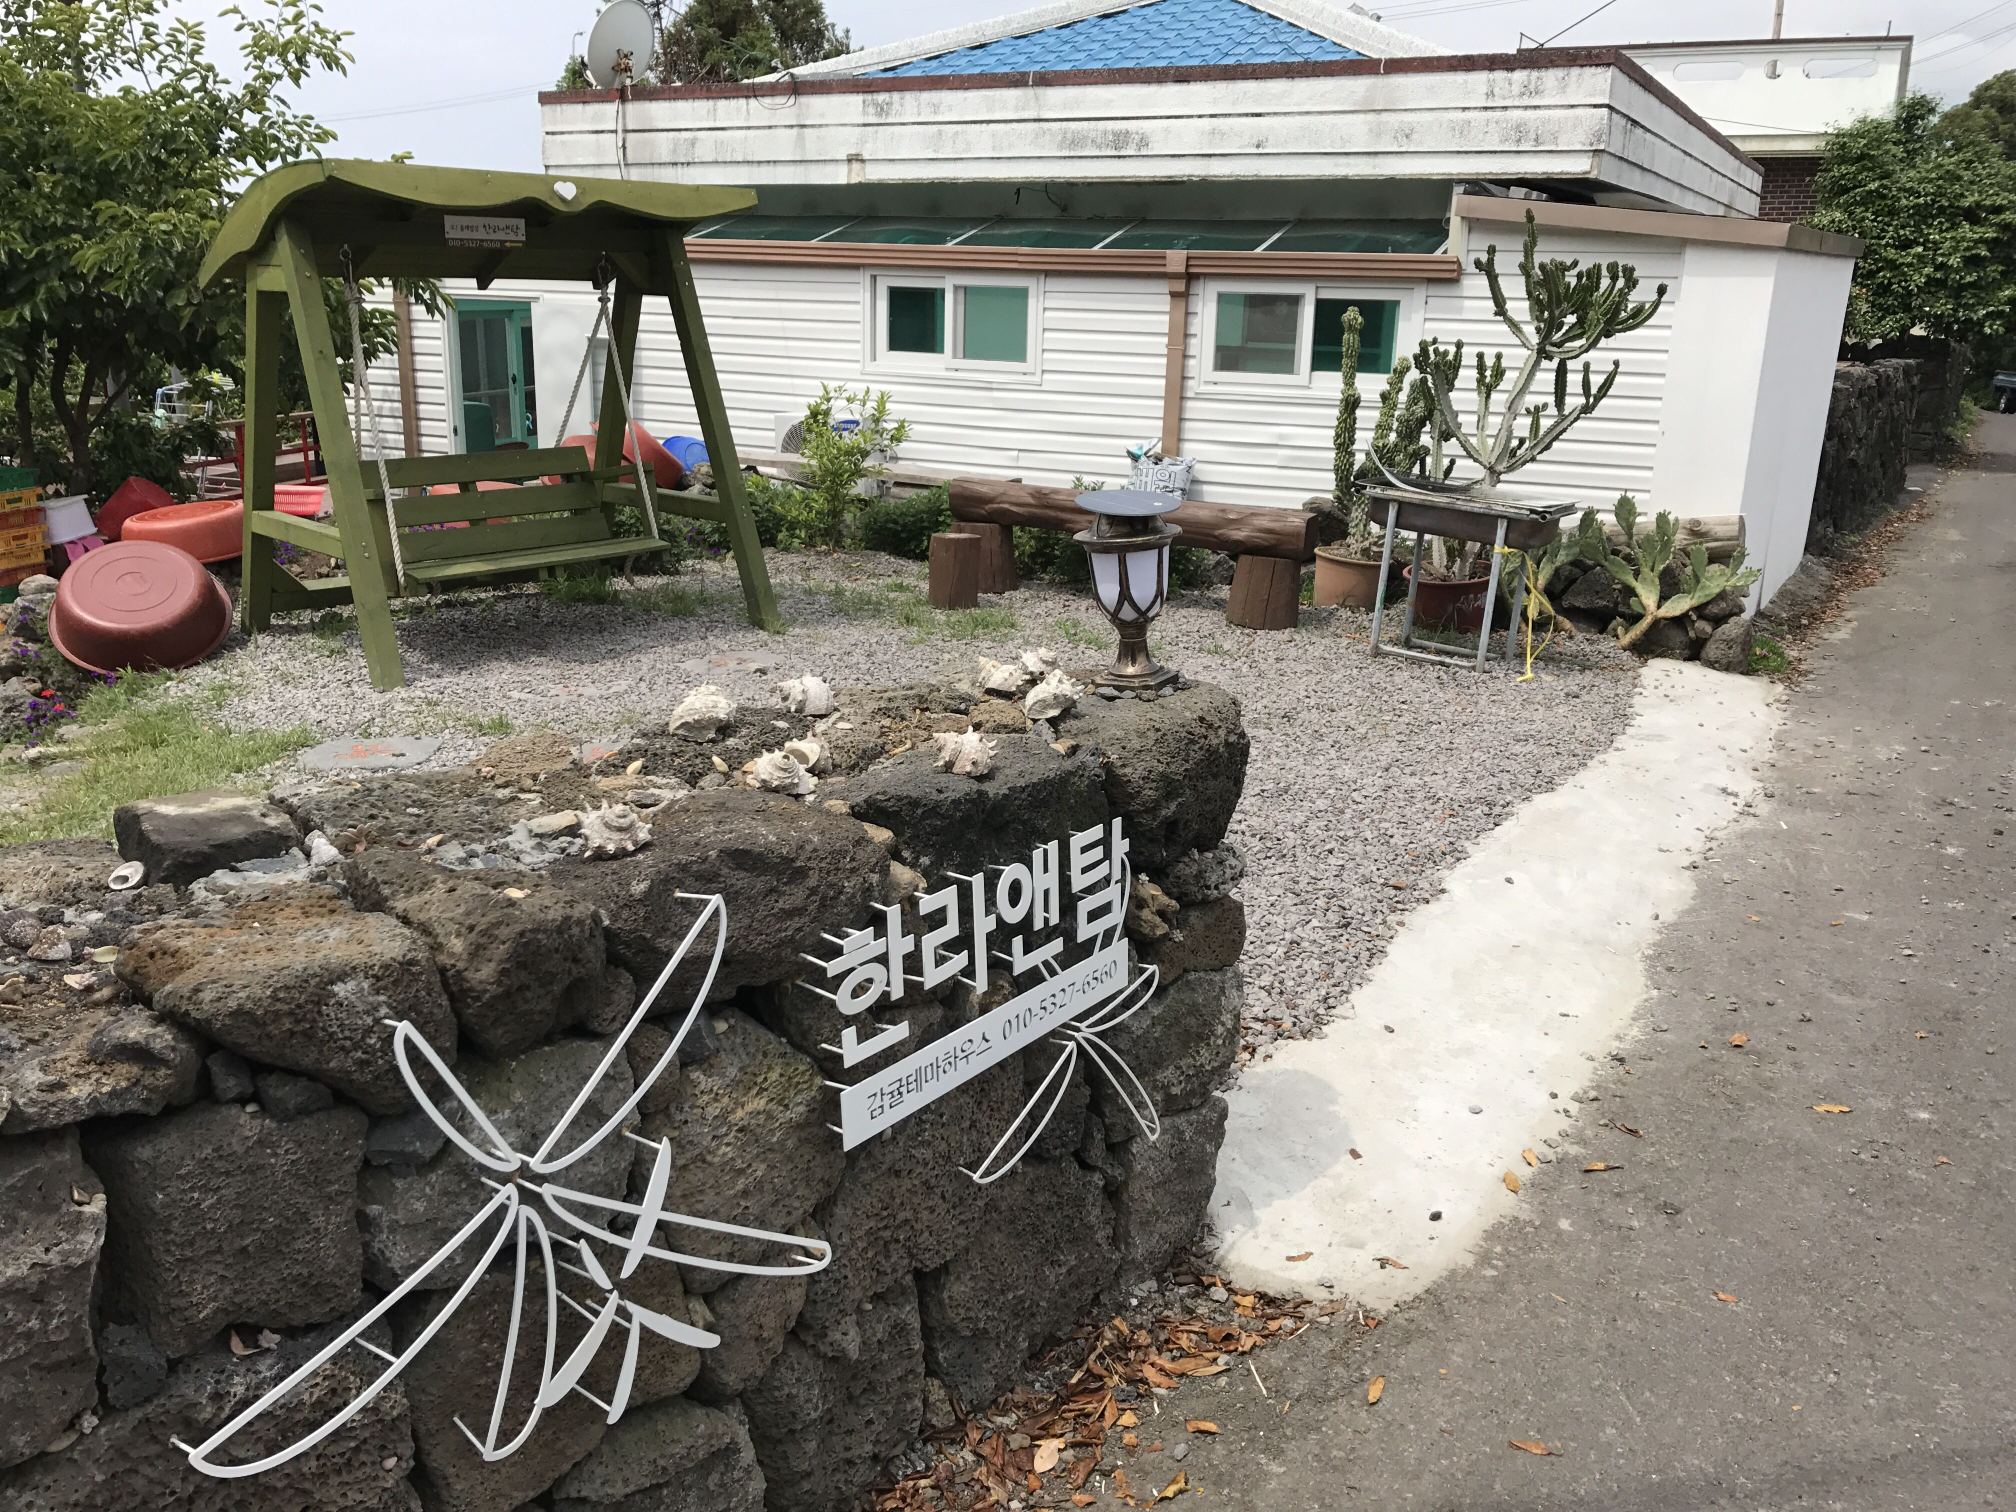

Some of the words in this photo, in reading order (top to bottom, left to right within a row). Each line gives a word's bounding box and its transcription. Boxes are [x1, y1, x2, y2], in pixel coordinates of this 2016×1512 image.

[827, 817, 1129, 1068] 한라앤탐
[867, 1031, 993, 1120] 감귤테마하우스
[1002, 959, 1118, 1040] 010-5327-6560
